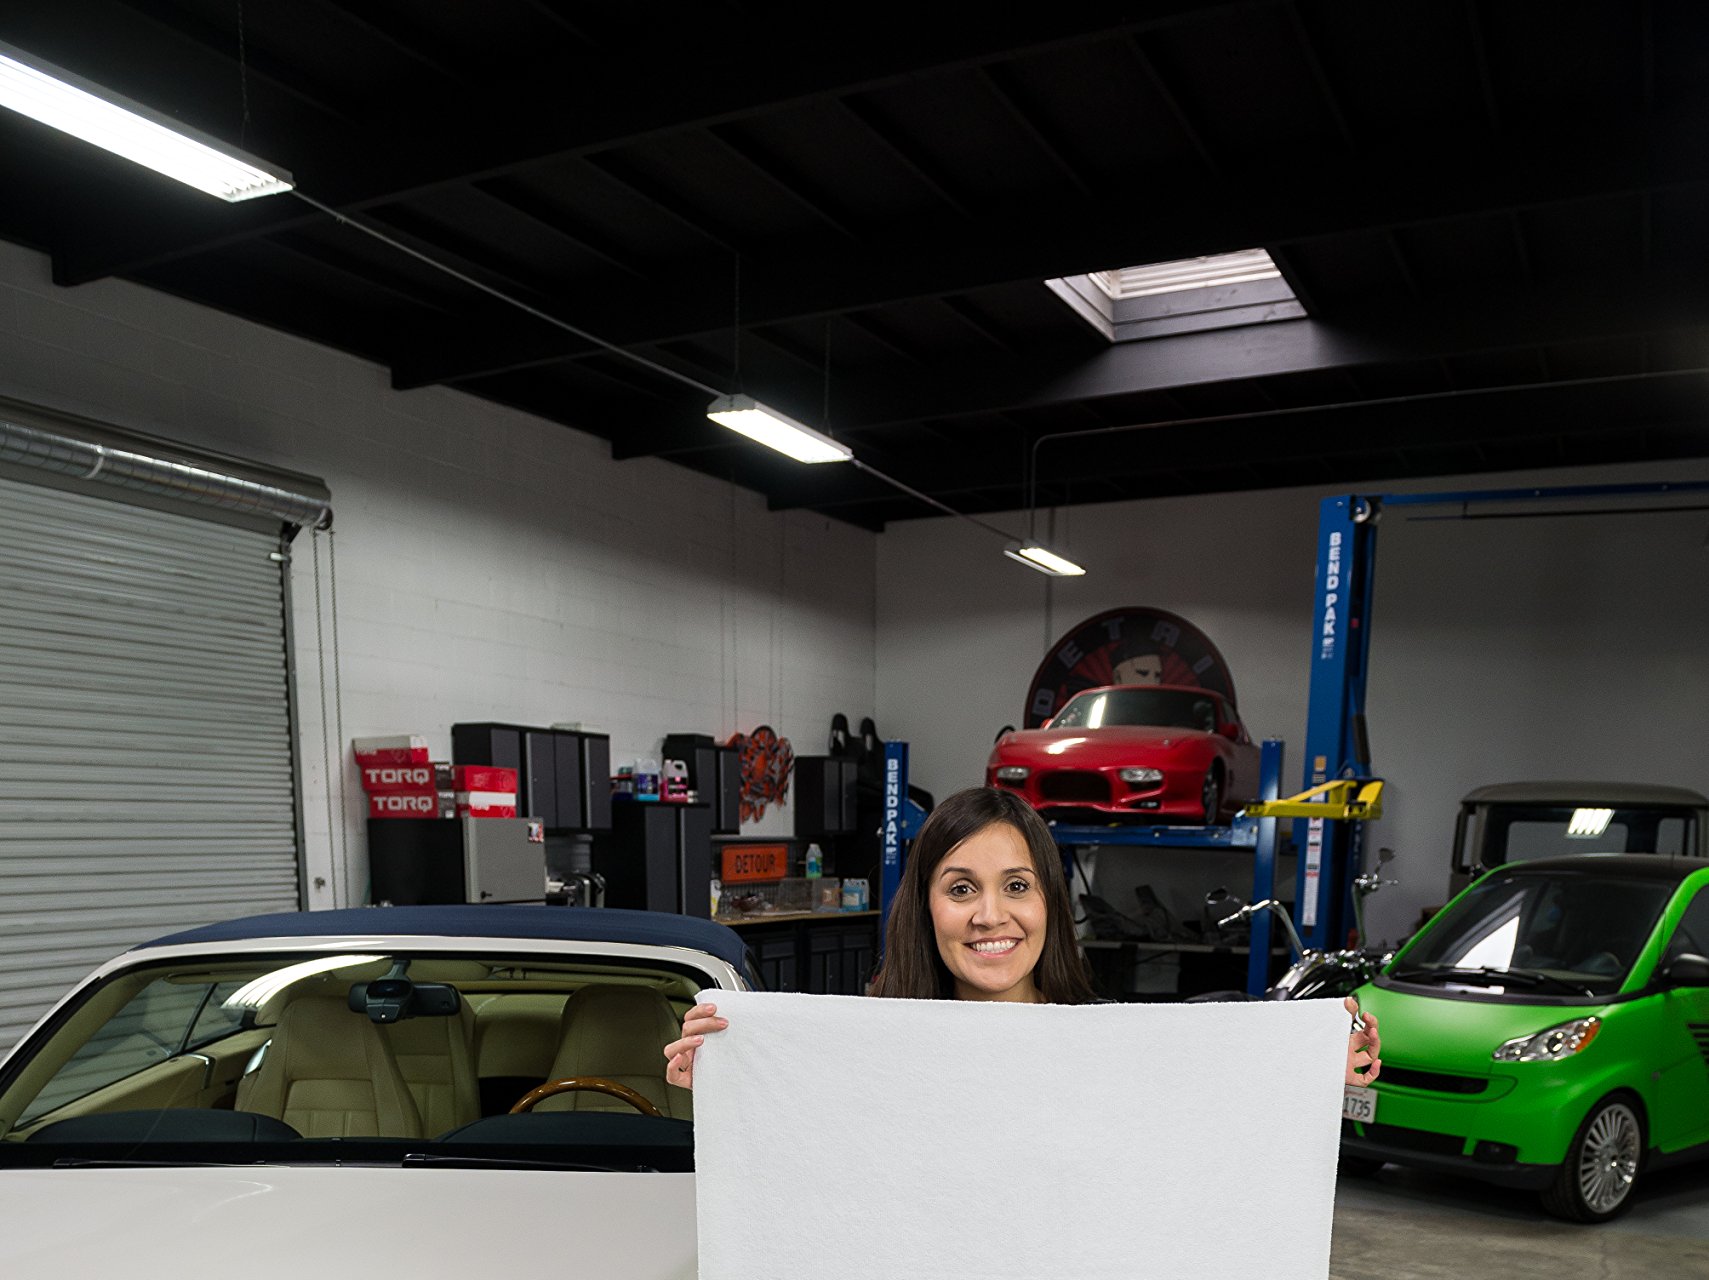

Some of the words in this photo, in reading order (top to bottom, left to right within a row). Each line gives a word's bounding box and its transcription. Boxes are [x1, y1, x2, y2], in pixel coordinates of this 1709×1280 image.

[1323, 531, 1341, 635] BENDPAK
[1032, 617, 1214, 716] DETAI
[365, 768, 430, 785] TORQ
[886, 759, 898, 845] BENDPAK
[373, 796, 433, 812] TORQ
[735, 854, 775, 873] DETOUR
